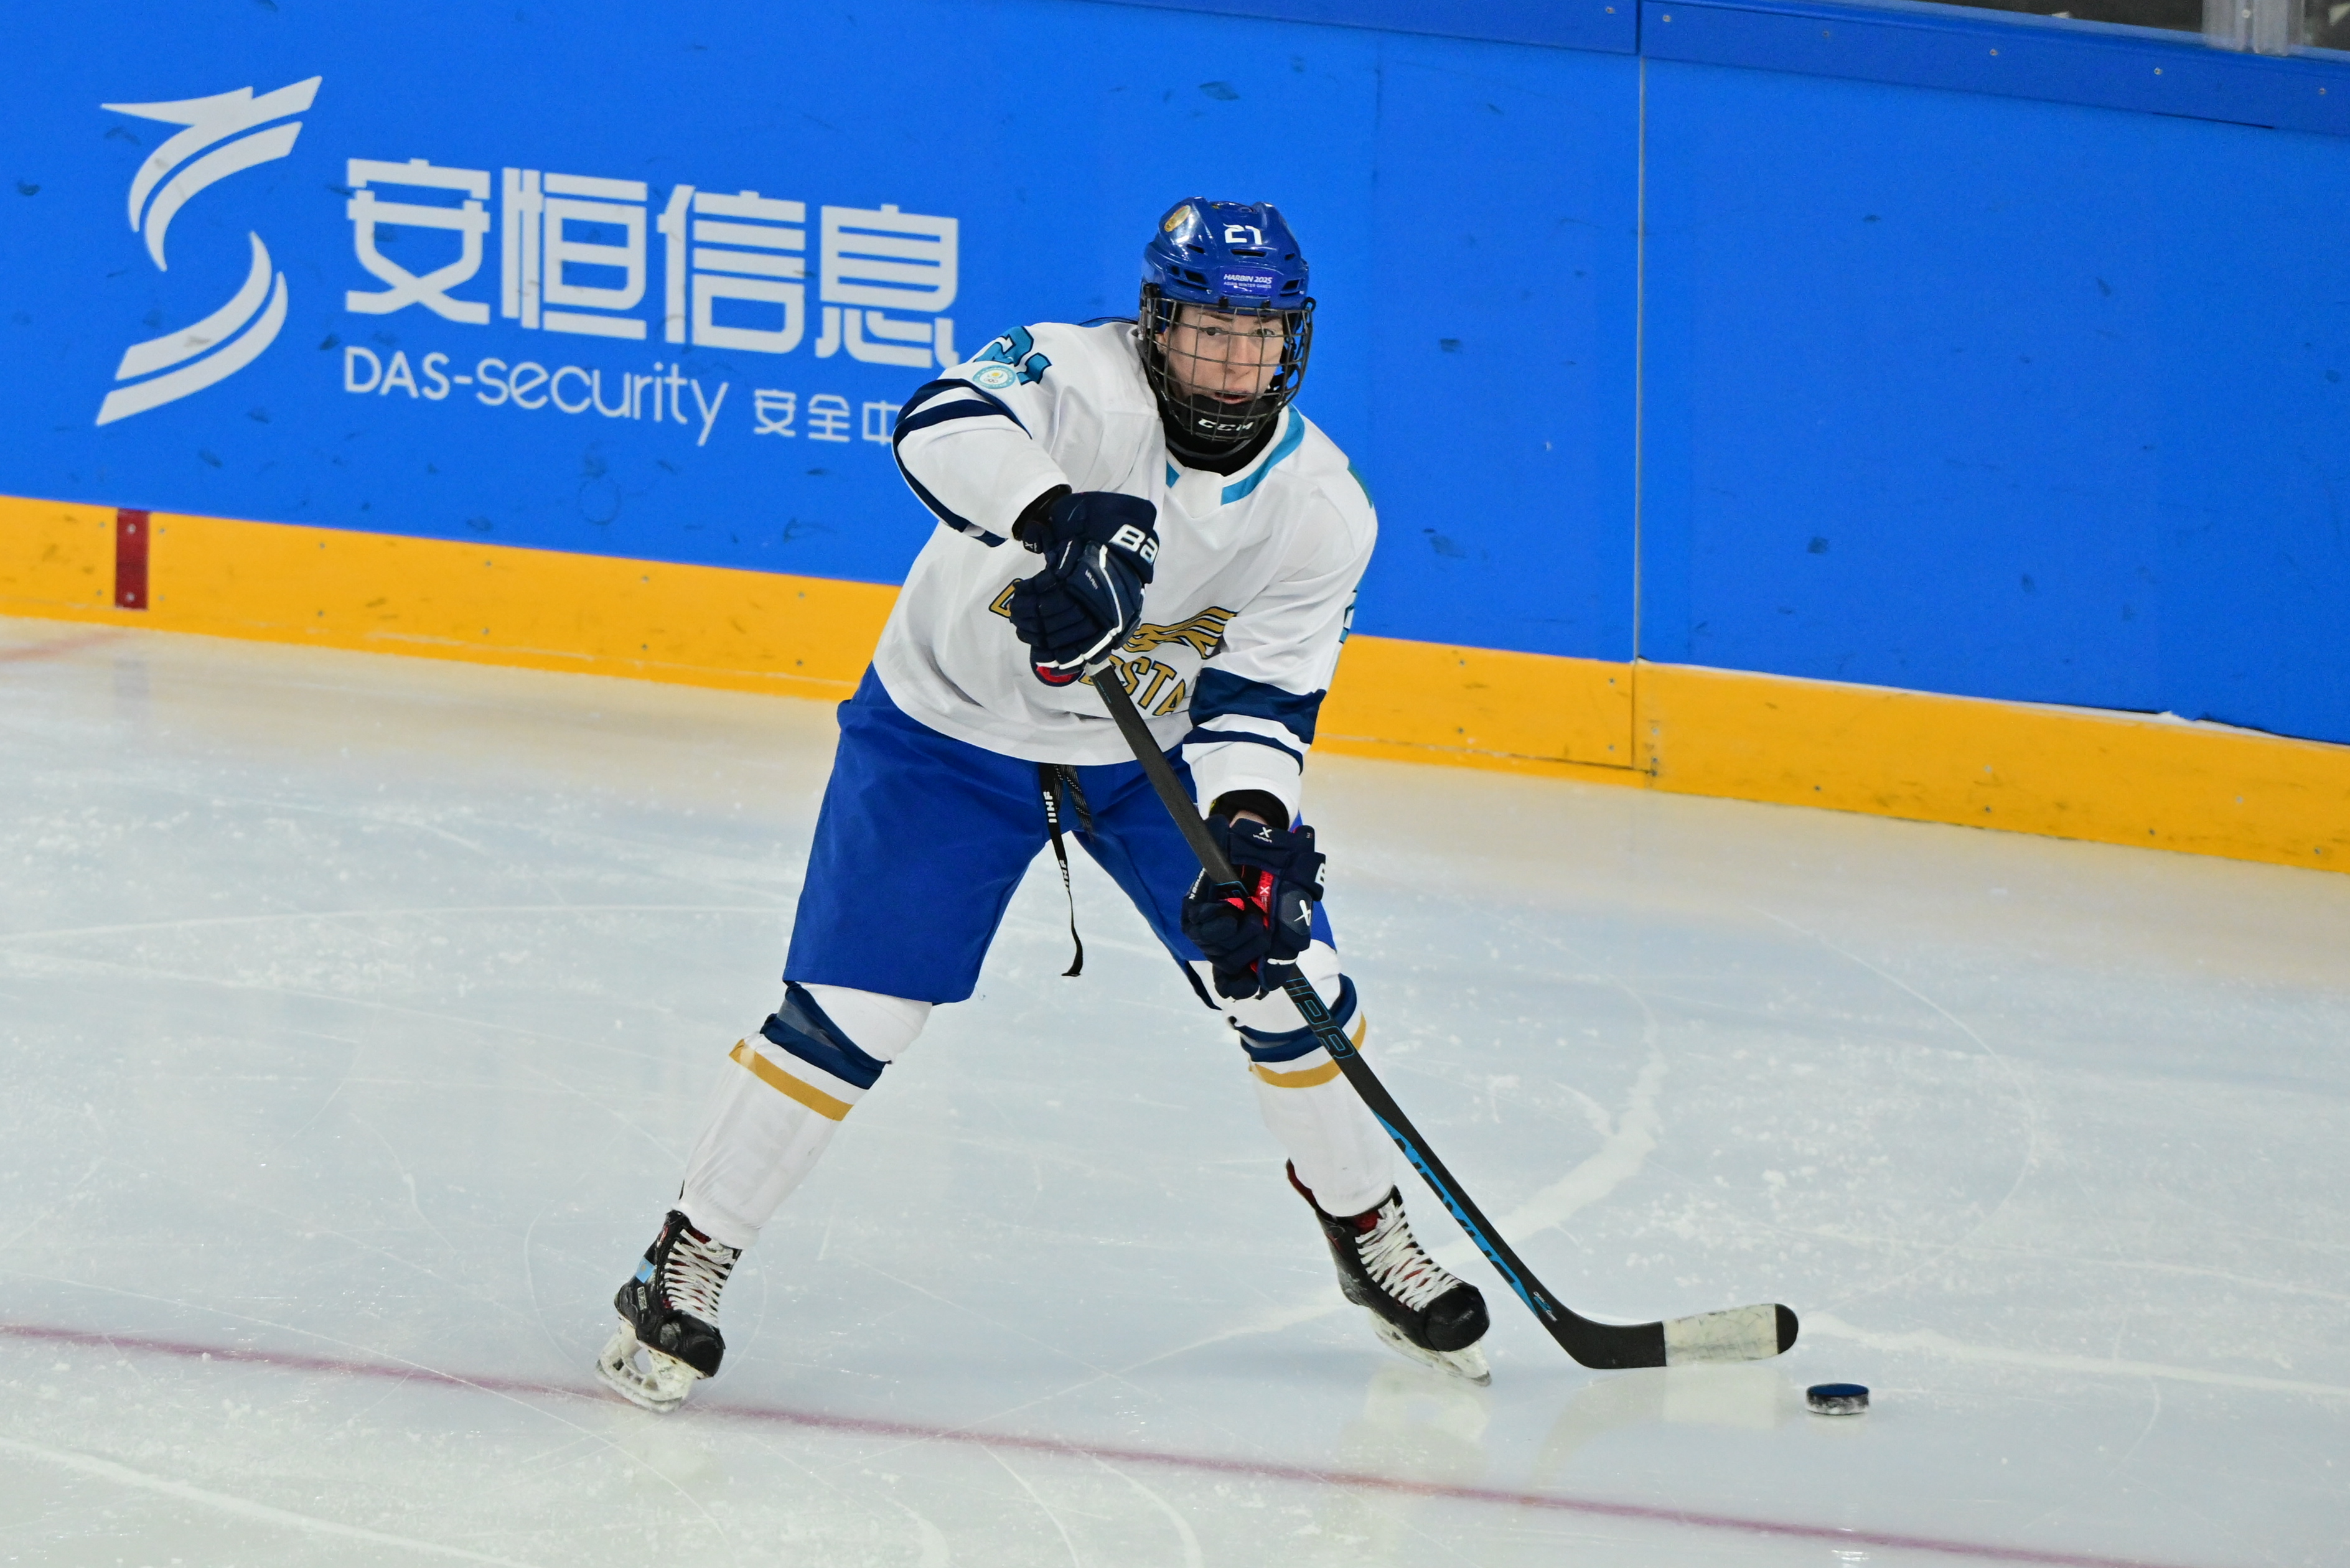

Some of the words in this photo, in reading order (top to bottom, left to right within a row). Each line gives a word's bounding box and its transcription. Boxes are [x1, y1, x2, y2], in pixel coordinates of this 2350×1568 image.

[1223, 222, 1262, 245] 21
[346, 159, 959, 368] 安恒信息
[1224, 274, 1253, 282] HARBIN
[1253, 276, 1273, 284] 2025
[345, 347, 729, 446] DAS-security
[754, 389, 902, 446] 安全中
[1198, 418, 1255, 432] CCM
